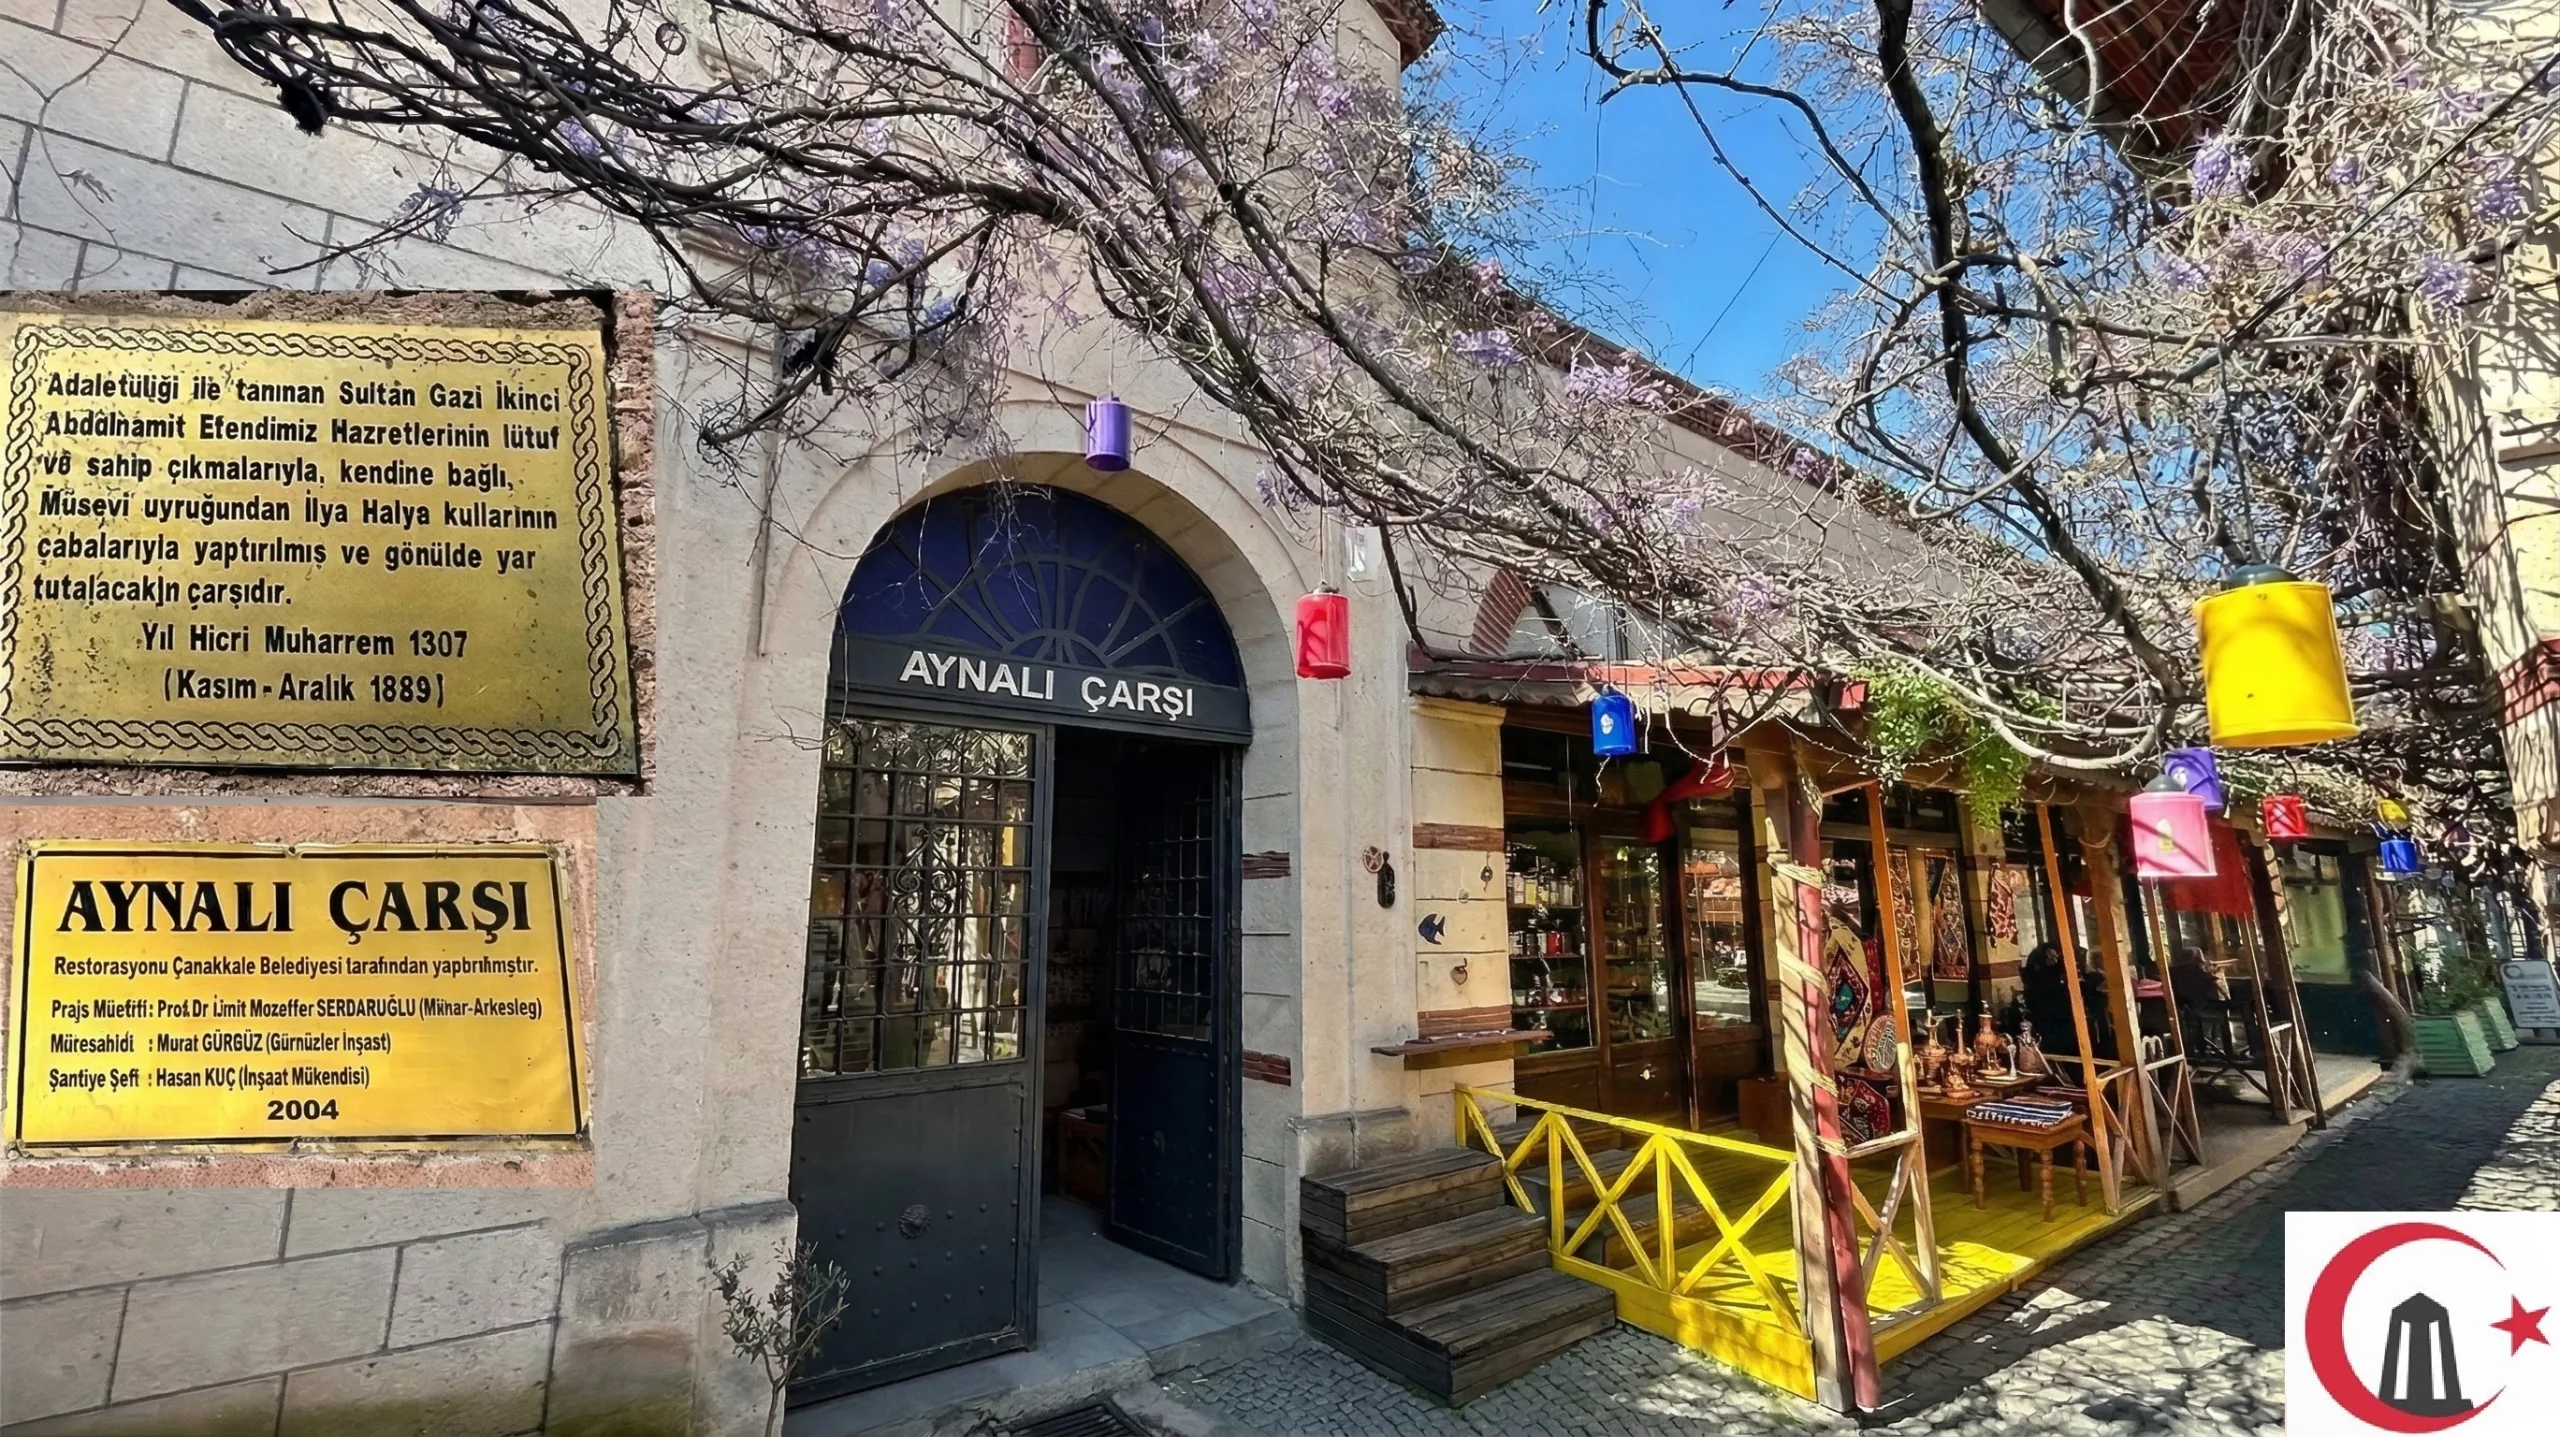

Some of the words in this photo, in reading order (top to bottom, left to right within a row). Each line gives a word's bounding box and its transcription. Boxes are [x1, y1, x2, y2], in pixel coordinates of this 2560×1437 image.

[192, 375, 221, 401] ile
[235, 377, 324, 404] tanınan
[339, 380, 416, 406] Sultan
[429, 382, 483, 410] Gazi
[496, 380, 560, 412] İkinci
[199, 413, 318, 443] Efendimiz
[331, 418, 490, 448] Hazretlerinin
[503, 423, 560, 450] lütuf
[87, 452, 152, 482] sahip
[167, 453, 325, 488] çıkmalarıyla,
[340, 458, 434, 486] kendine
[447, 460, 514, 493] bağlı,
[144, 492, 290, 525] uyruğundan
[304, 488, 348, 528] İlya
[362, 498, 431, 530] Halya
[37, 531, 180, 566] çabalarıyla
[194, 535, 327, 570] yaptırılmış
[341, 544, 371, 566] ve
[384, 540, 483, 572] gönülde
[496, 548, 537, 575] yar
[187, 576, 293, 610] çarşıdır.
[141, 622, 175, 652] Yıl
[189, 624, 249, 653] Hicri
[264, 625, 395, 656] Muharrem
[409, 629, 468, 658] 1307
[370, 673, 444, 708] 1889)
[899, 650, 1055, 701] AYNALI
[1080, 675, 1194, 722] ÇARŞI
[55, 879, 295, 933] AYNALI
[328, 879, 532, 946] ÇARŞI
[54, 955, 169, 980] Restorasyonu
[172, 955, 256, 980] Çanakkale
[260, 955, 342, 980] Belediyesi
[346, 955, 429, 975] tarafından
[250, 997, 315, 1018] Mozeffer
[316, 994, 416, 1018] SERDARUĞLU
[157, 1032, 199, 1053] Murat
[202, 1028, 264, 1053] GÜRGÜZ
[266, 1031, 340, 1056] (Gürnüzler
[342, 1029, 392, 1056] İnşast)
[49, 1067, 107, 1092] Şantiye
[156, 1067, 201, 1088] Hasan
[204, 1066, 236, 1092] KUÇ
[238, 1064, 289, 1092] (İnşaat
[291, 1065, 370, 1090] Mükendisi)
[267, 1098, 340, 1121] 2004
